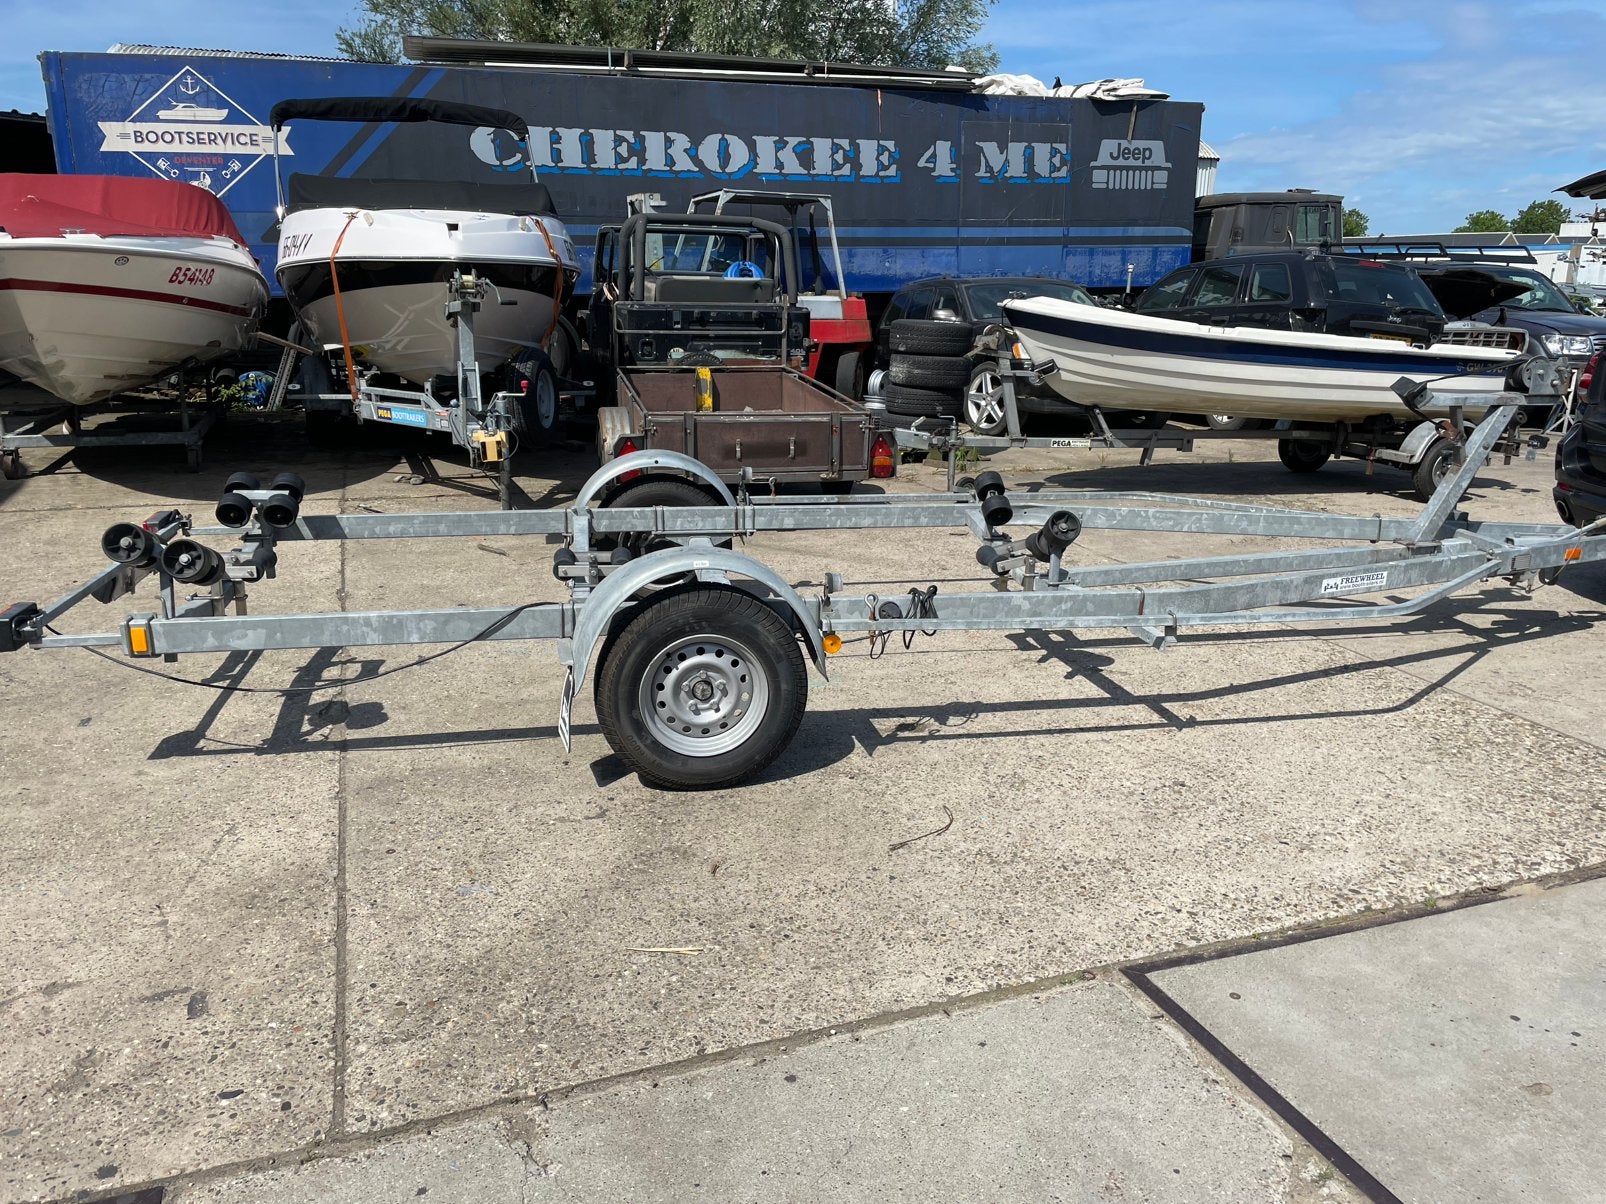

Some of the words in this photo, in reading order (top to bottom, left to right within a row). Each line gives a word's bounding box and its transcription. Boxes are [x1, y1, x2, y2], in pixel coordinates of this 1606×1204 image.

[133, 130, 260, 146] BOOTSERVICE
[469, 125, 900, 180] CHEROKEE
[917, 140, 960, 182] 4
[975, 141, 1070, 184] ME
[1109, 143, 1152, 164] Jeep
[174, 156, 224, 165] DEVENTER
[377, 408, 392, 419] PEGA
[1340, 573, 1385, 584] FREEWHEEL
